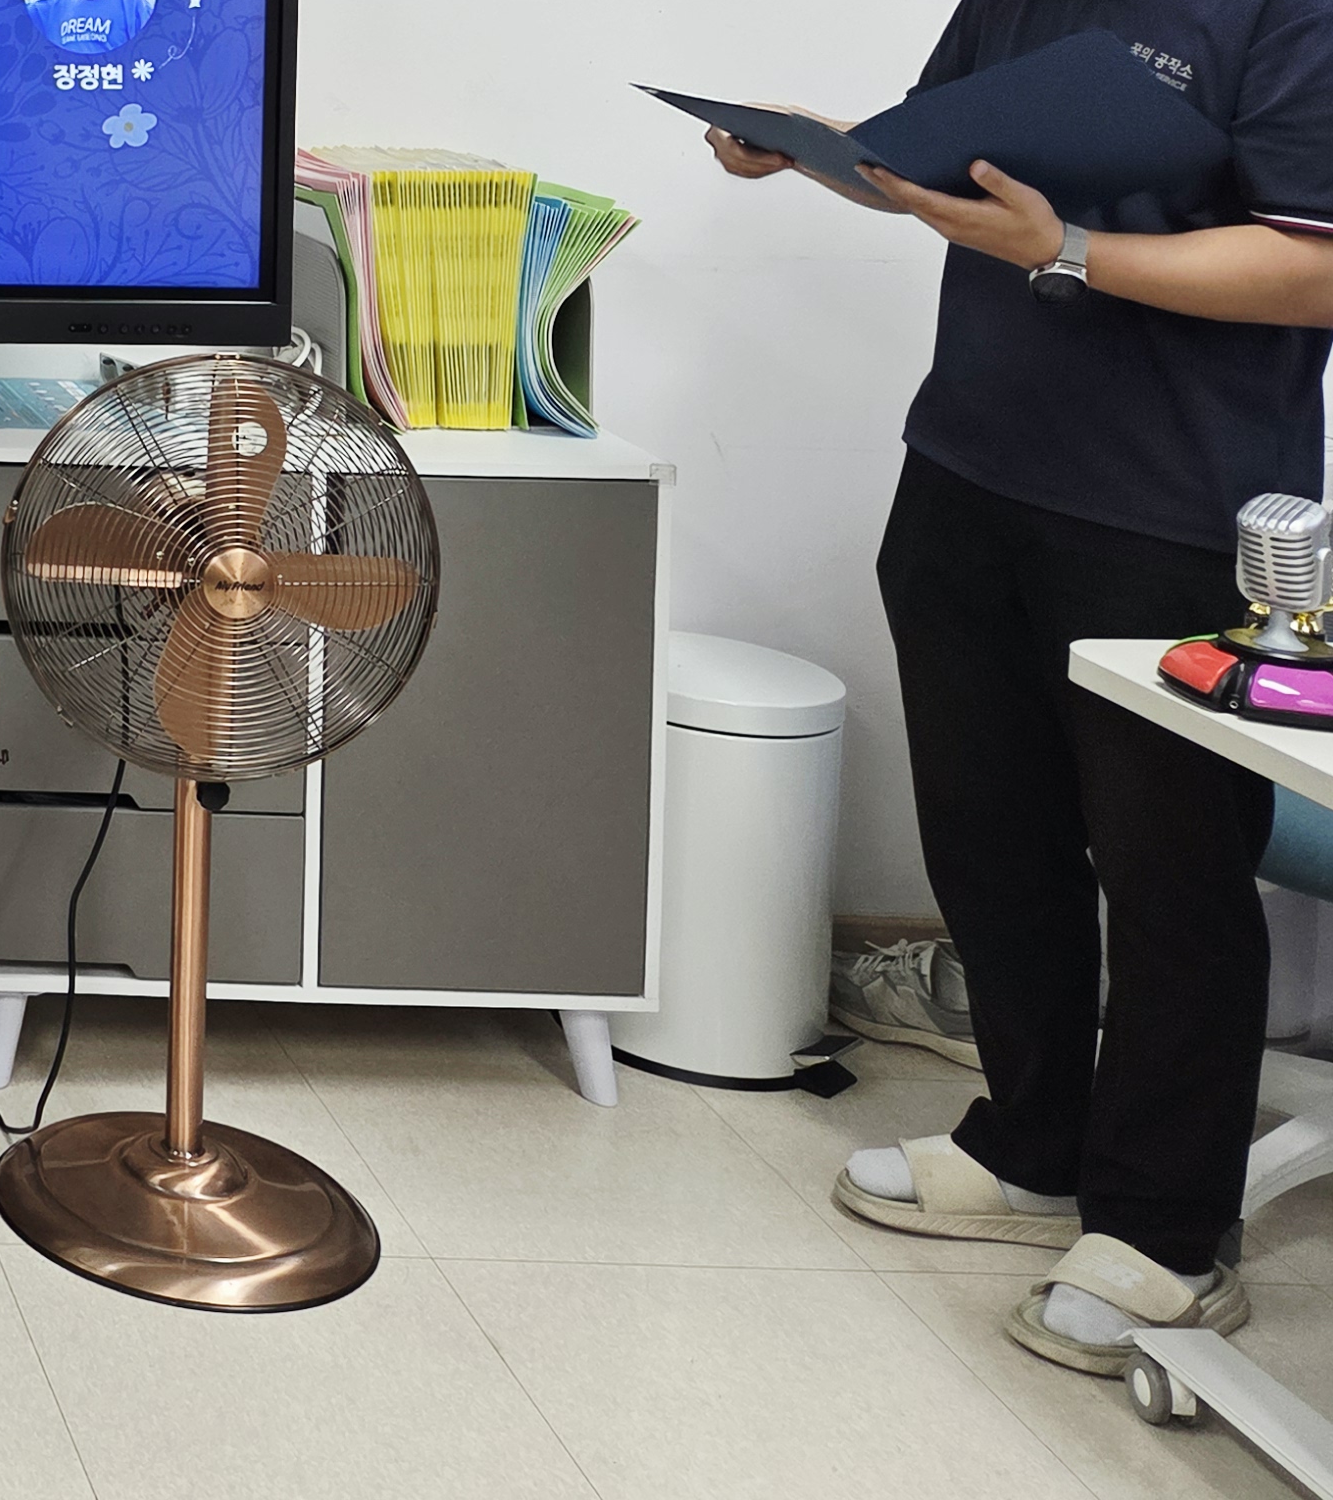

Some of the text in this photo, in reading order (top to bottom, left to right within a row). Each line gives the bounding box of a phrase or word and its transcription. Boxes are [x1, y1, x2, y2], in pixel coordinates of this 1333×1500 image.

[61, 16, 112, 36] DREAM
[53, 63, 124, 91] 장정현
[1154, 52, 1193, 80] 공작소
